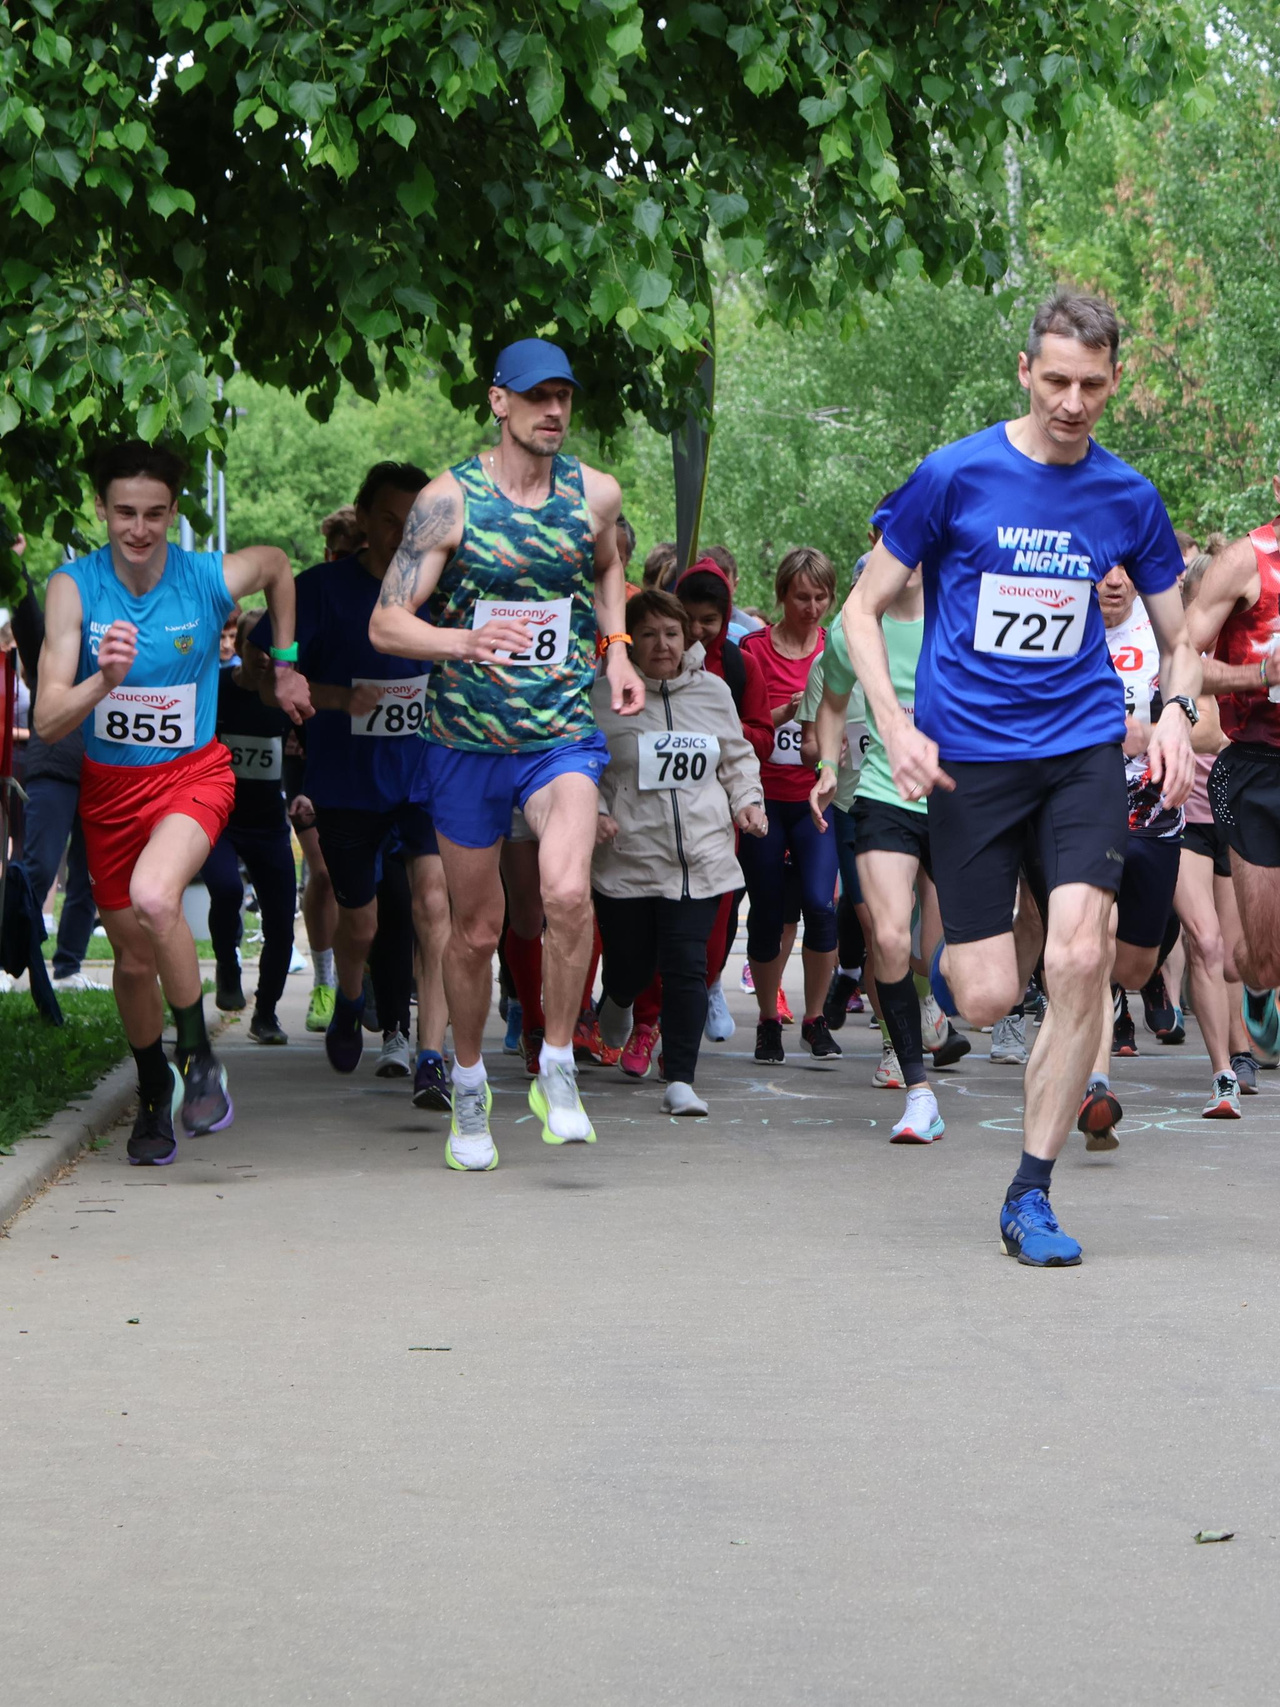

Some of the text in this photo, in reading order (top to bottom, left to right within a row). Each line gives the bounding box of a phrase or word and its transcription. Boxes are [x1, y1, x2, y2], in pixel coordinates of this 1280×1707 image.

[997, 526, 1072, 553] WHITE
[1012, 549, 1091, 577] NIGHTS
[998, 584, 1062, 600] saucony
[491, 607, 547, 619] saucony
[992, 610, 1075, 651] 727
[109, 691, 167, 705] saucony
[106, 711, 182, 744] 855
[366, 702, 423, 733] 789
[232, 747, 273, 769] 675
[656, 751, 707, 782] 780
